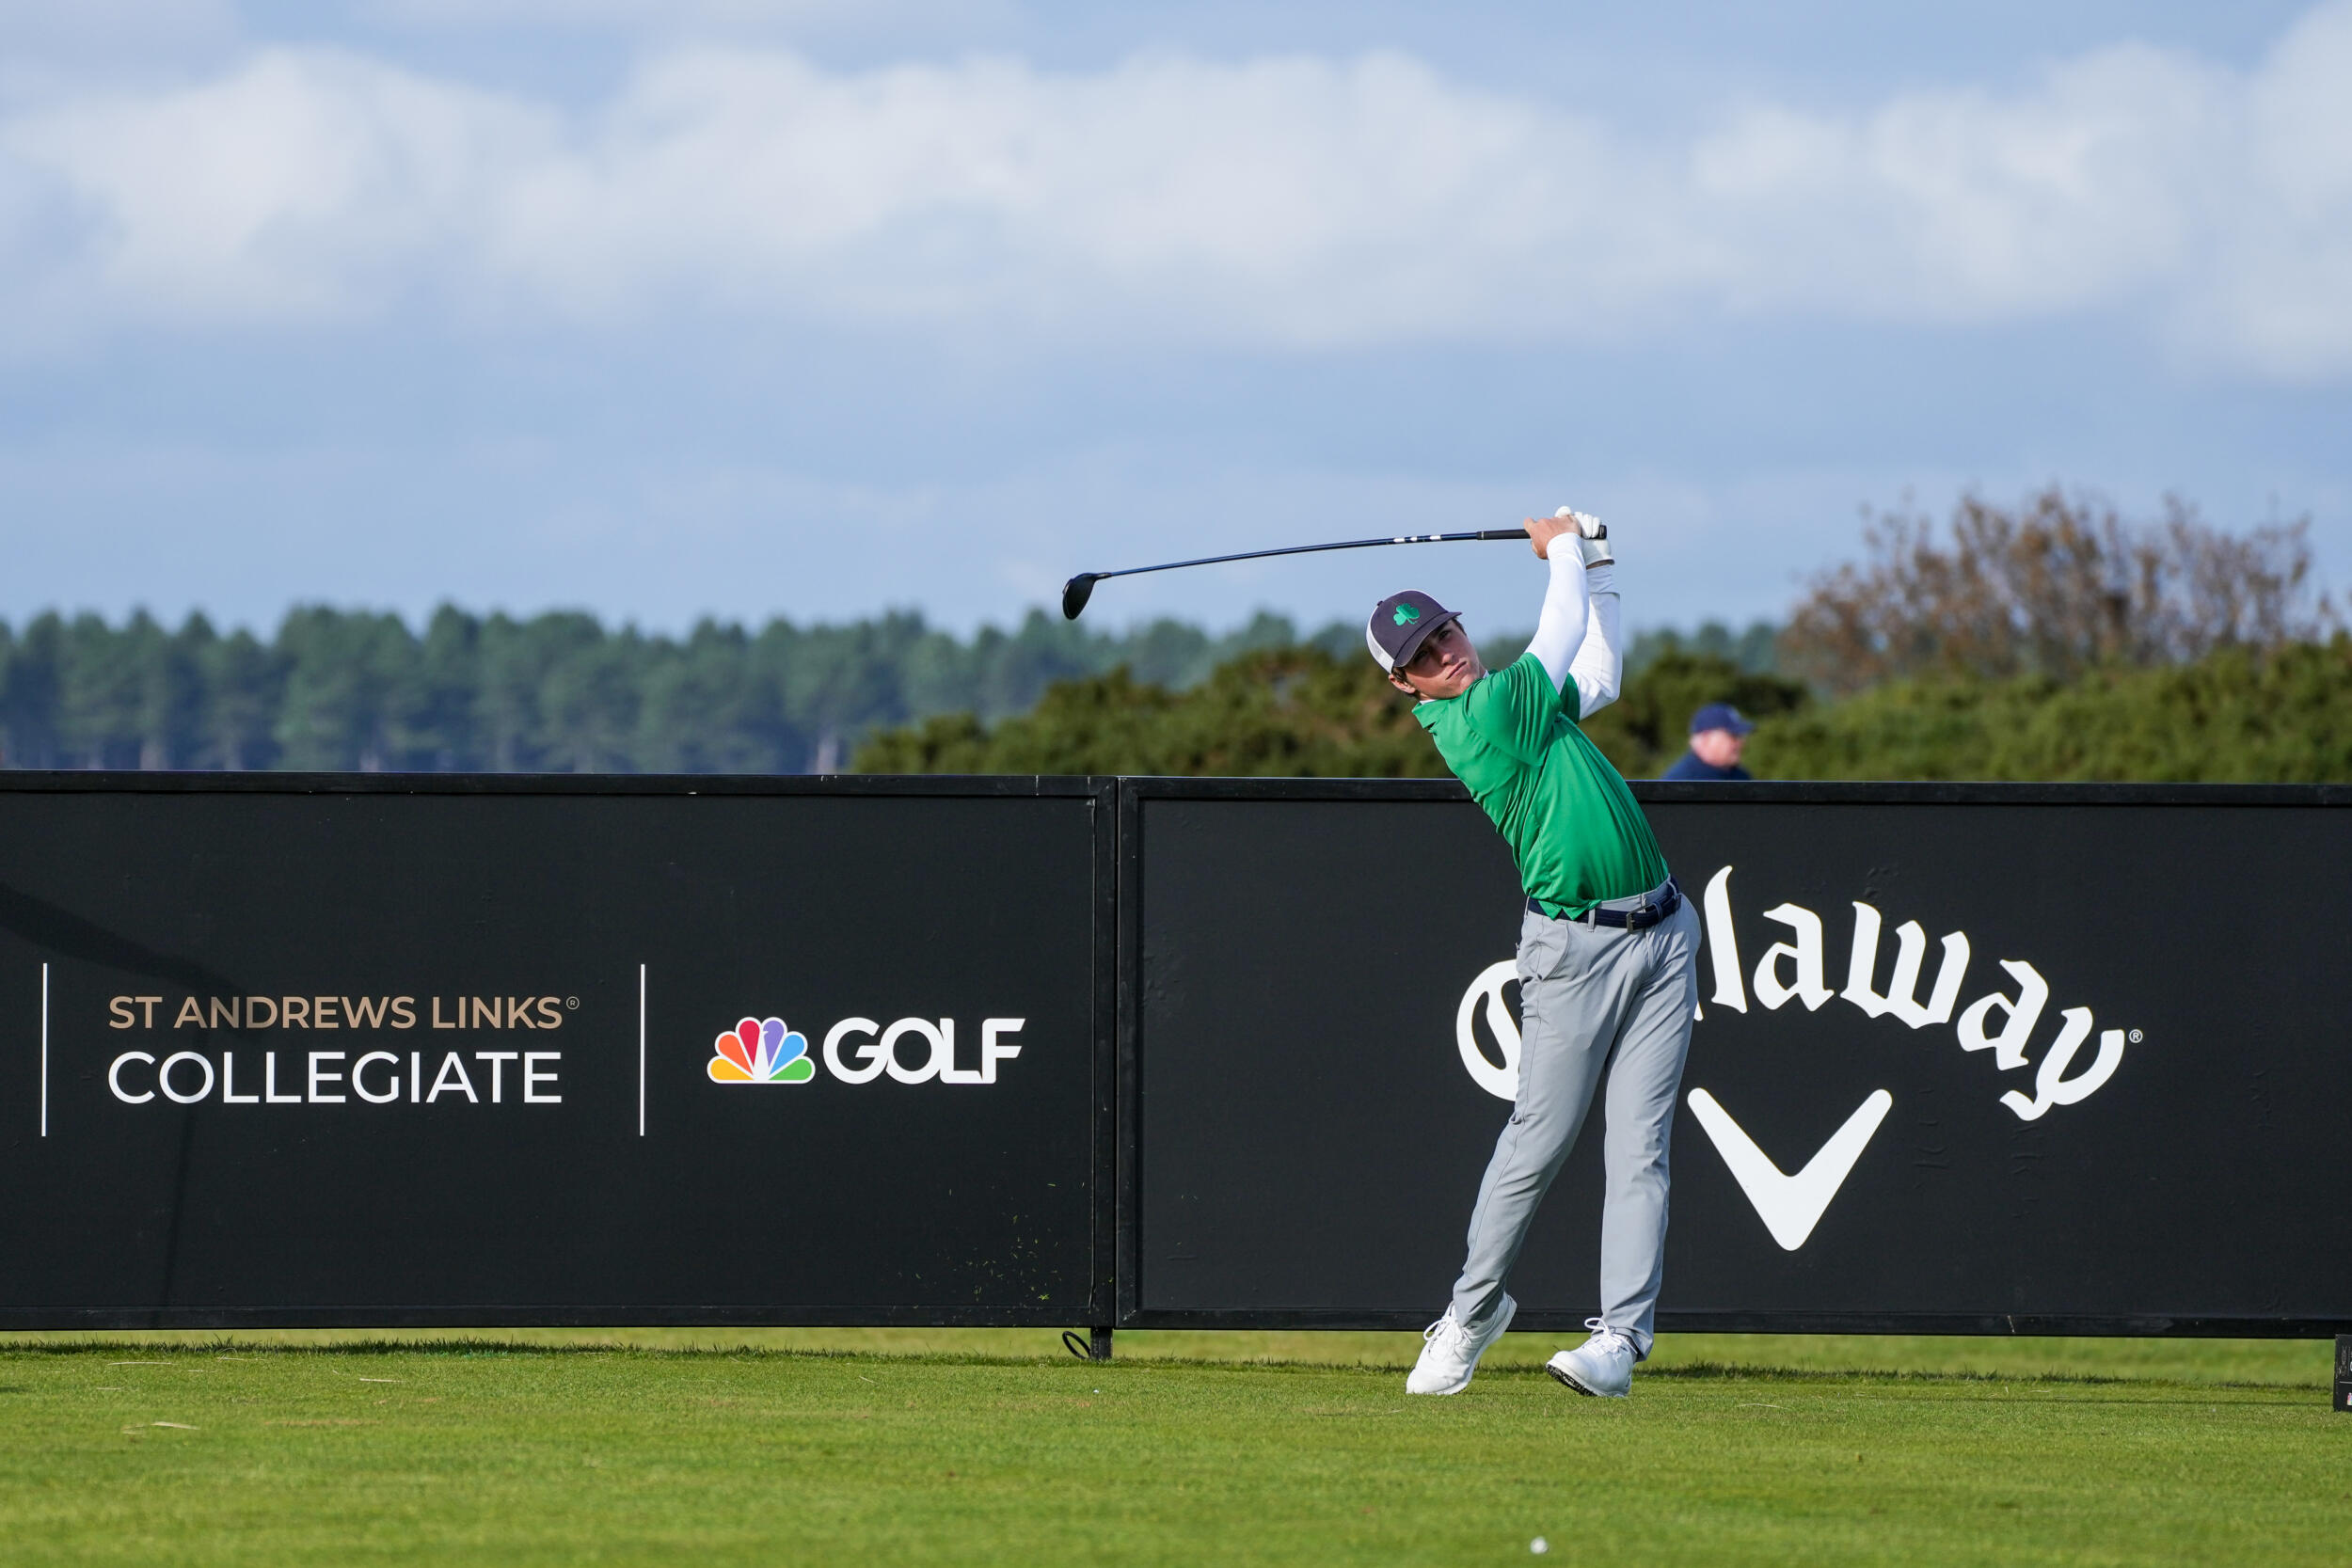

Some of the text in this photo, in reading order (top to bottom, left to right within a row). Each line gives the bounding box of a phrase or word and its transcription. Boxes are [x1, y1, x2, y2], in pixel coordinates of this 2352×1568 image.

[108, 996, 163, 1029] ST
[174, 996, 417, 1029] ANDREWS
[108, 1051, 563, 1103] COLLEGIATE
[822, 1017, 1026, 1085] GOLF
